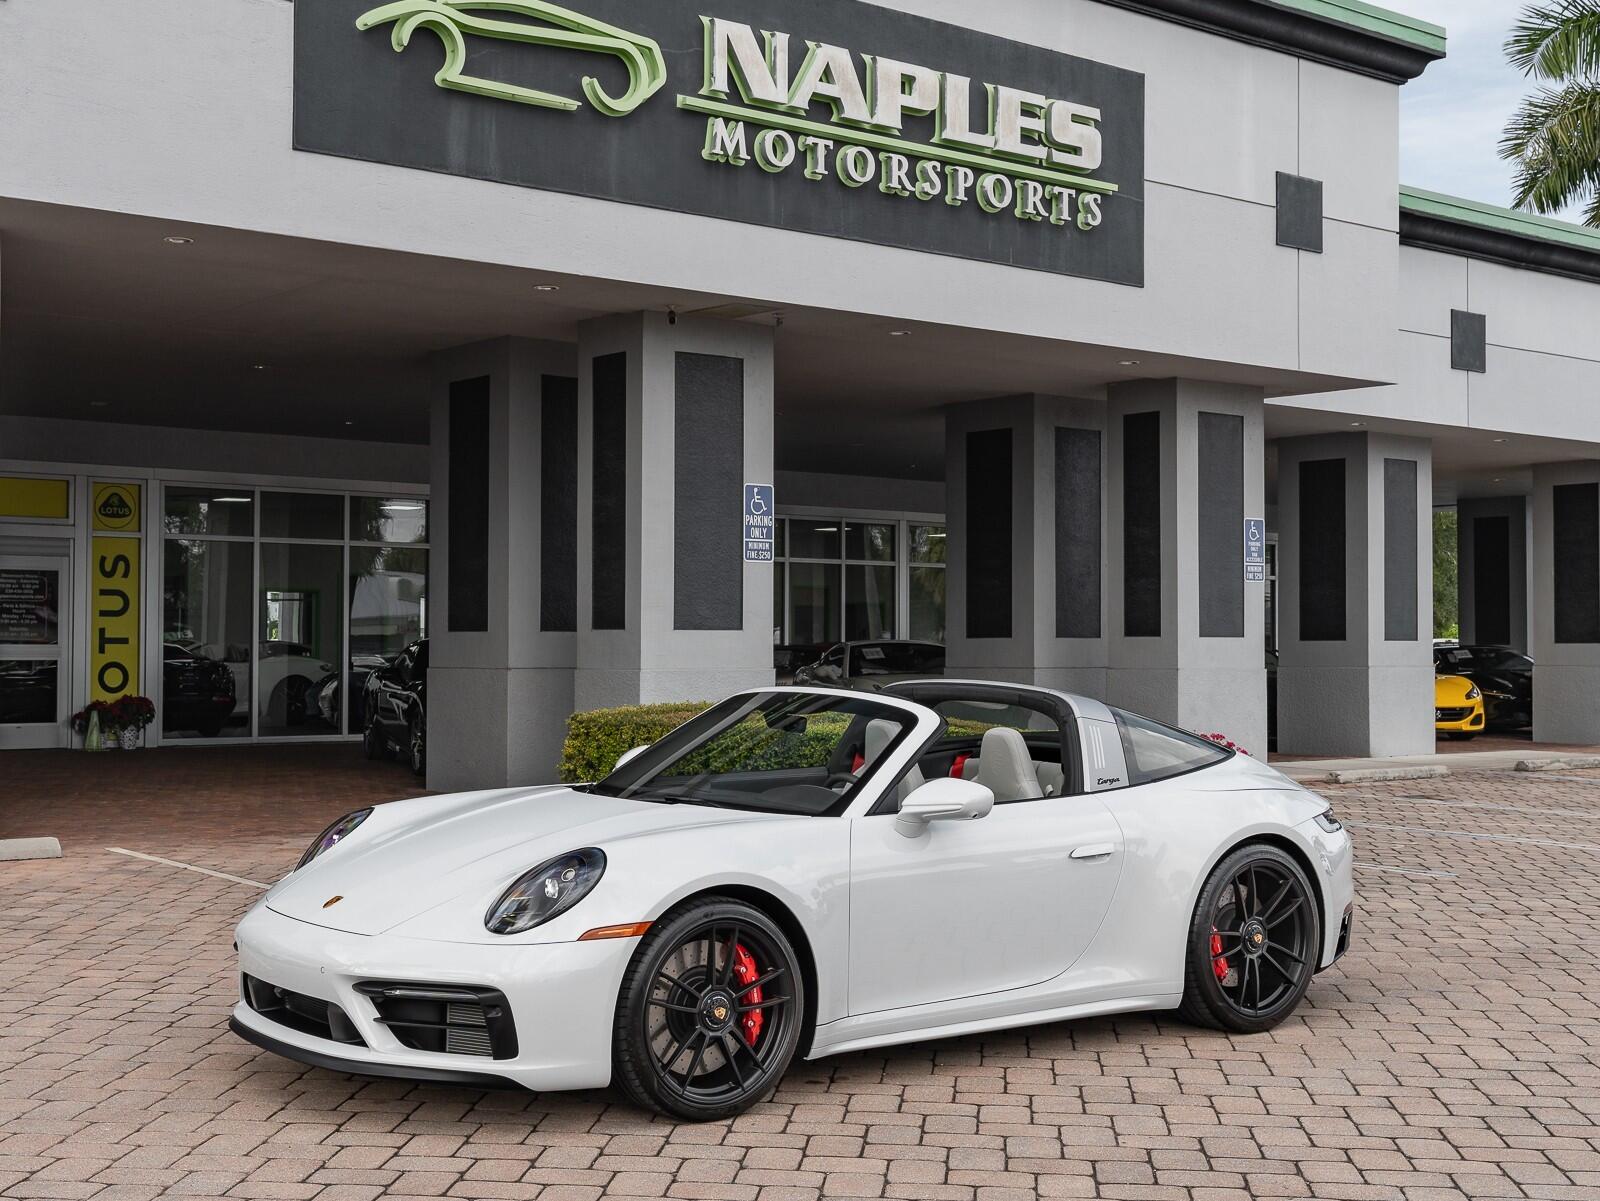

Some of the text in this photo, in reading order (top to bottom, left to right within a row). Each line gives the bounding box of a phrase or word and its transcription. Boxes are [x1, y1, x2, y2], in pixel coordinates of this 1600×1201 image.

[699, 14, 1102, 174] NAPLES
[701, 117, 1102, 230] MOTORSPORTS
[101, 507, 130, 515] LOTUS
[745, 514, 772, 527] PARKING
[750, 527, 768, 539] ONLY
[748, 541, 770, 550] MINIMUM
[746, 550, 771, 560] FINE $250
[98, 554, 130, 693] OTUS
